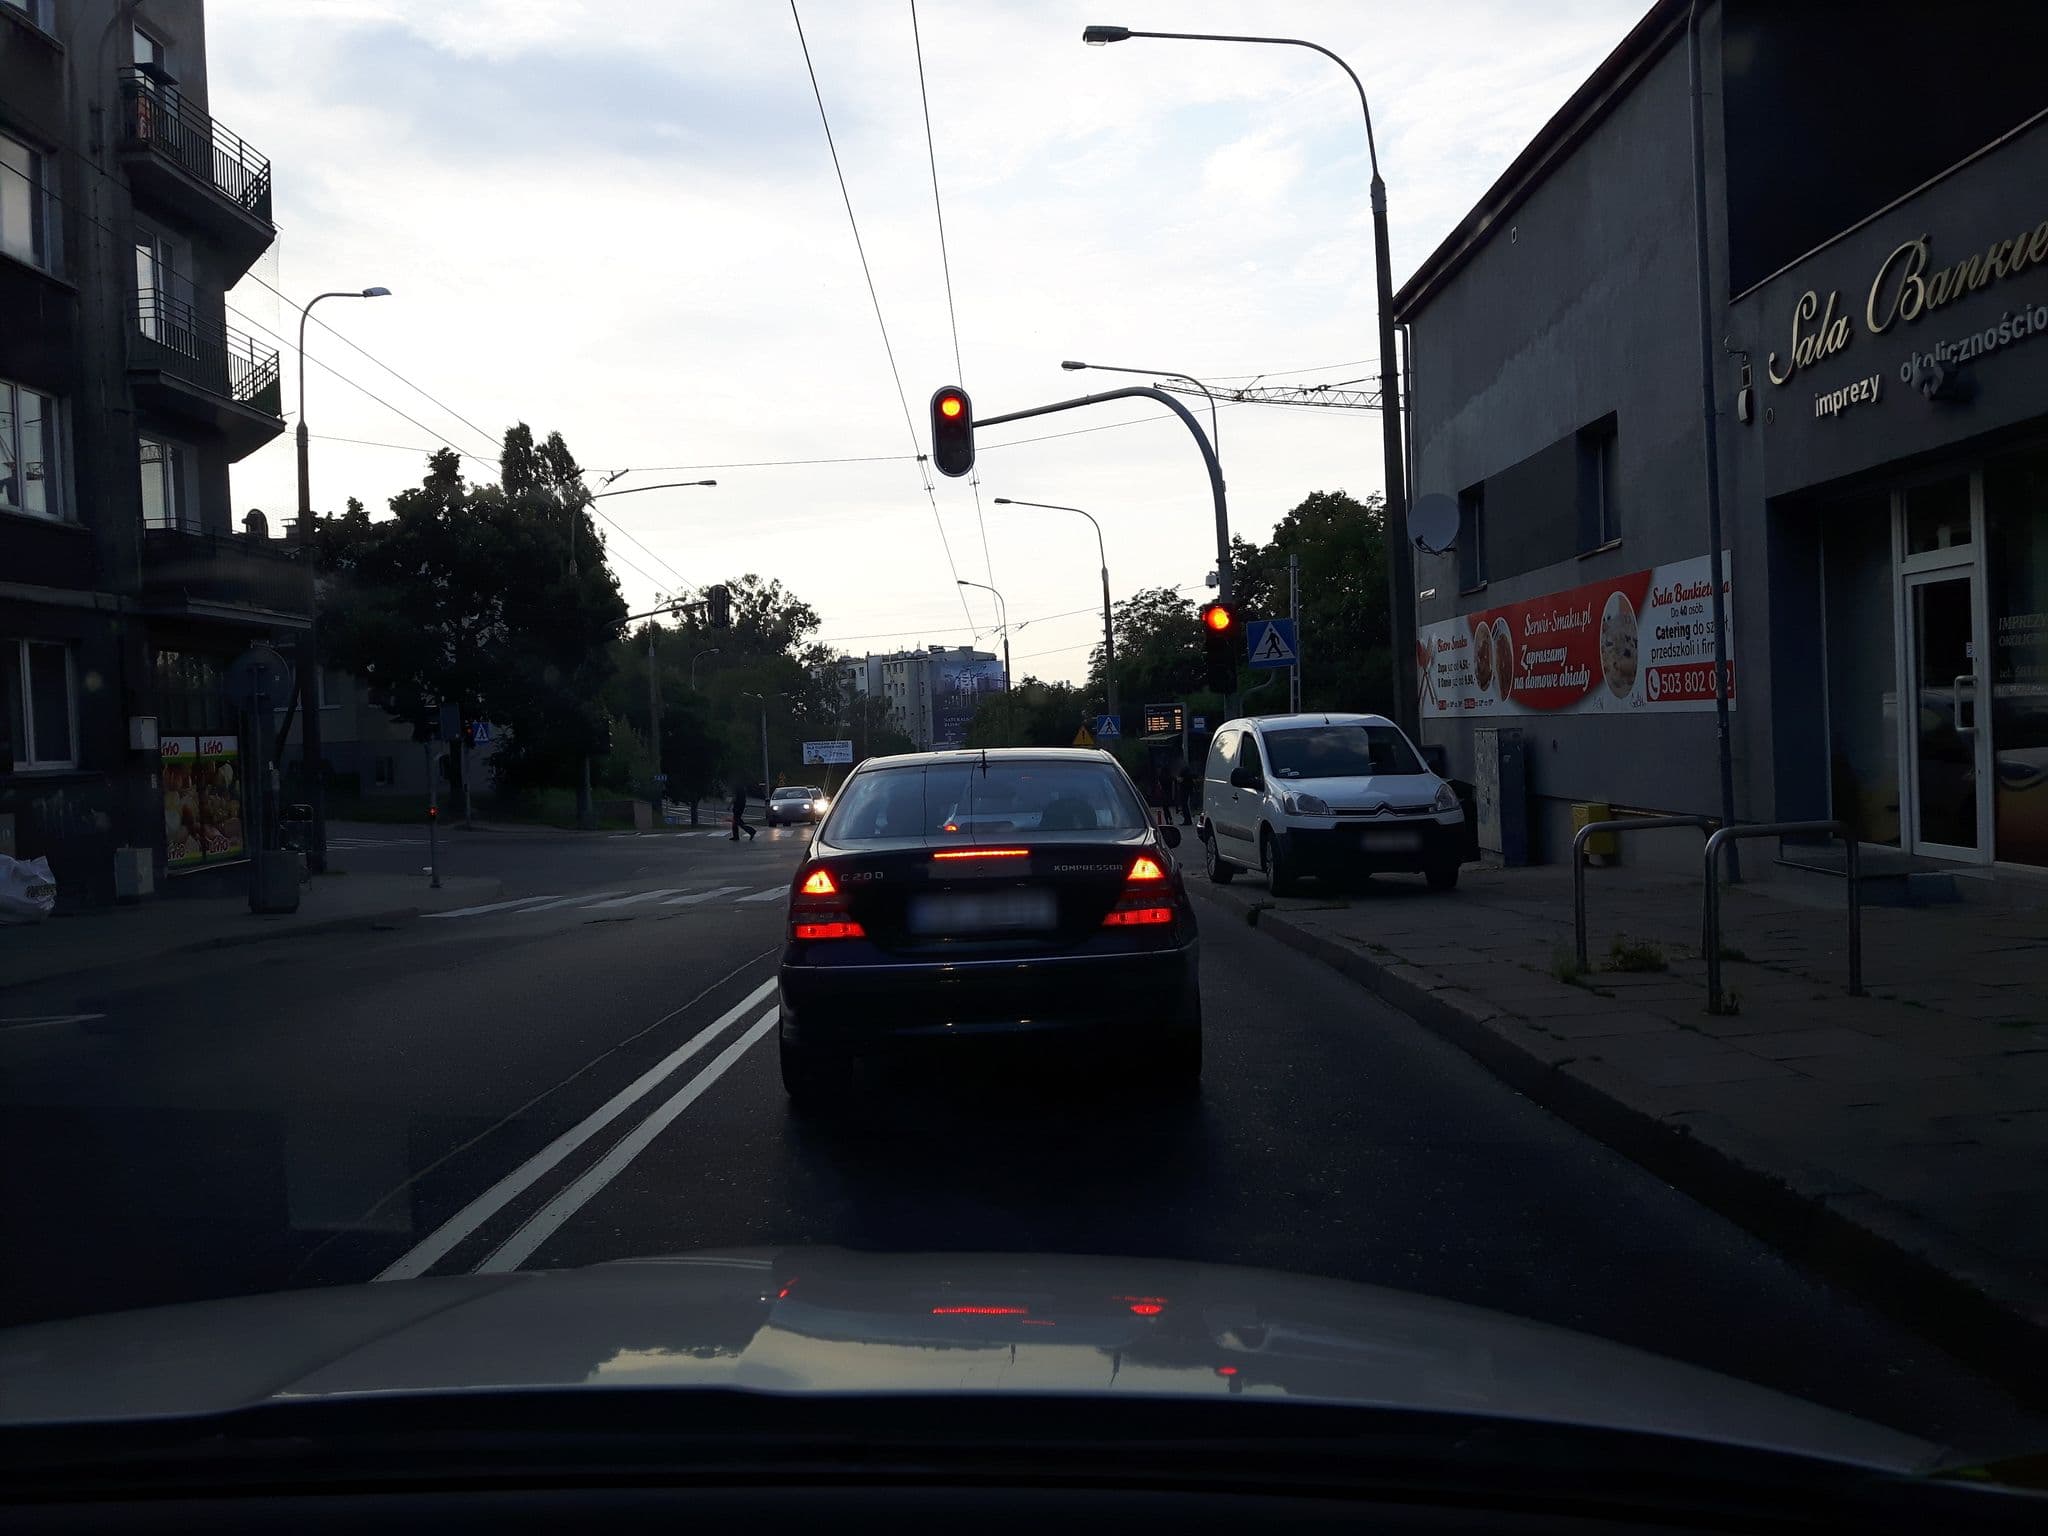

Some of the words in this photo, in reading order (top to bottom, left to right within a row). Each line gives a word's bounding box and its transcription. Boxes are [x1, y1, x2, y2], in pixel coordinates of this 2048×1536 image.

[1768, 289, 1850, 385] Sala
[1866, 218, 2048, 334] Bankie
[1815, 373, 1880, 417] imprezy
[1652, 585, 1673, 608] Sala
[1524, 601, 1592, 637] Serwis-Smaku.pl
[1655, 623, 1691, 641] Catering
[1692, 620, 1704, 636] do
[1520, 644, 1567, 671] Zapraszamy
[1651, 640, 1695, 663] przedszkoli
[1696, 639, 1699, 655] i
[1513, 676, 1524, 690] na
[1525, 669, 1559, 689] domowe
[1559, 664, 1591, 693] obiady
[1661, 672, 1682, 694] 503
[1684, 670, 1706, 693] 802
[1054, 864, 1124, 873] KOMPRESSOR
